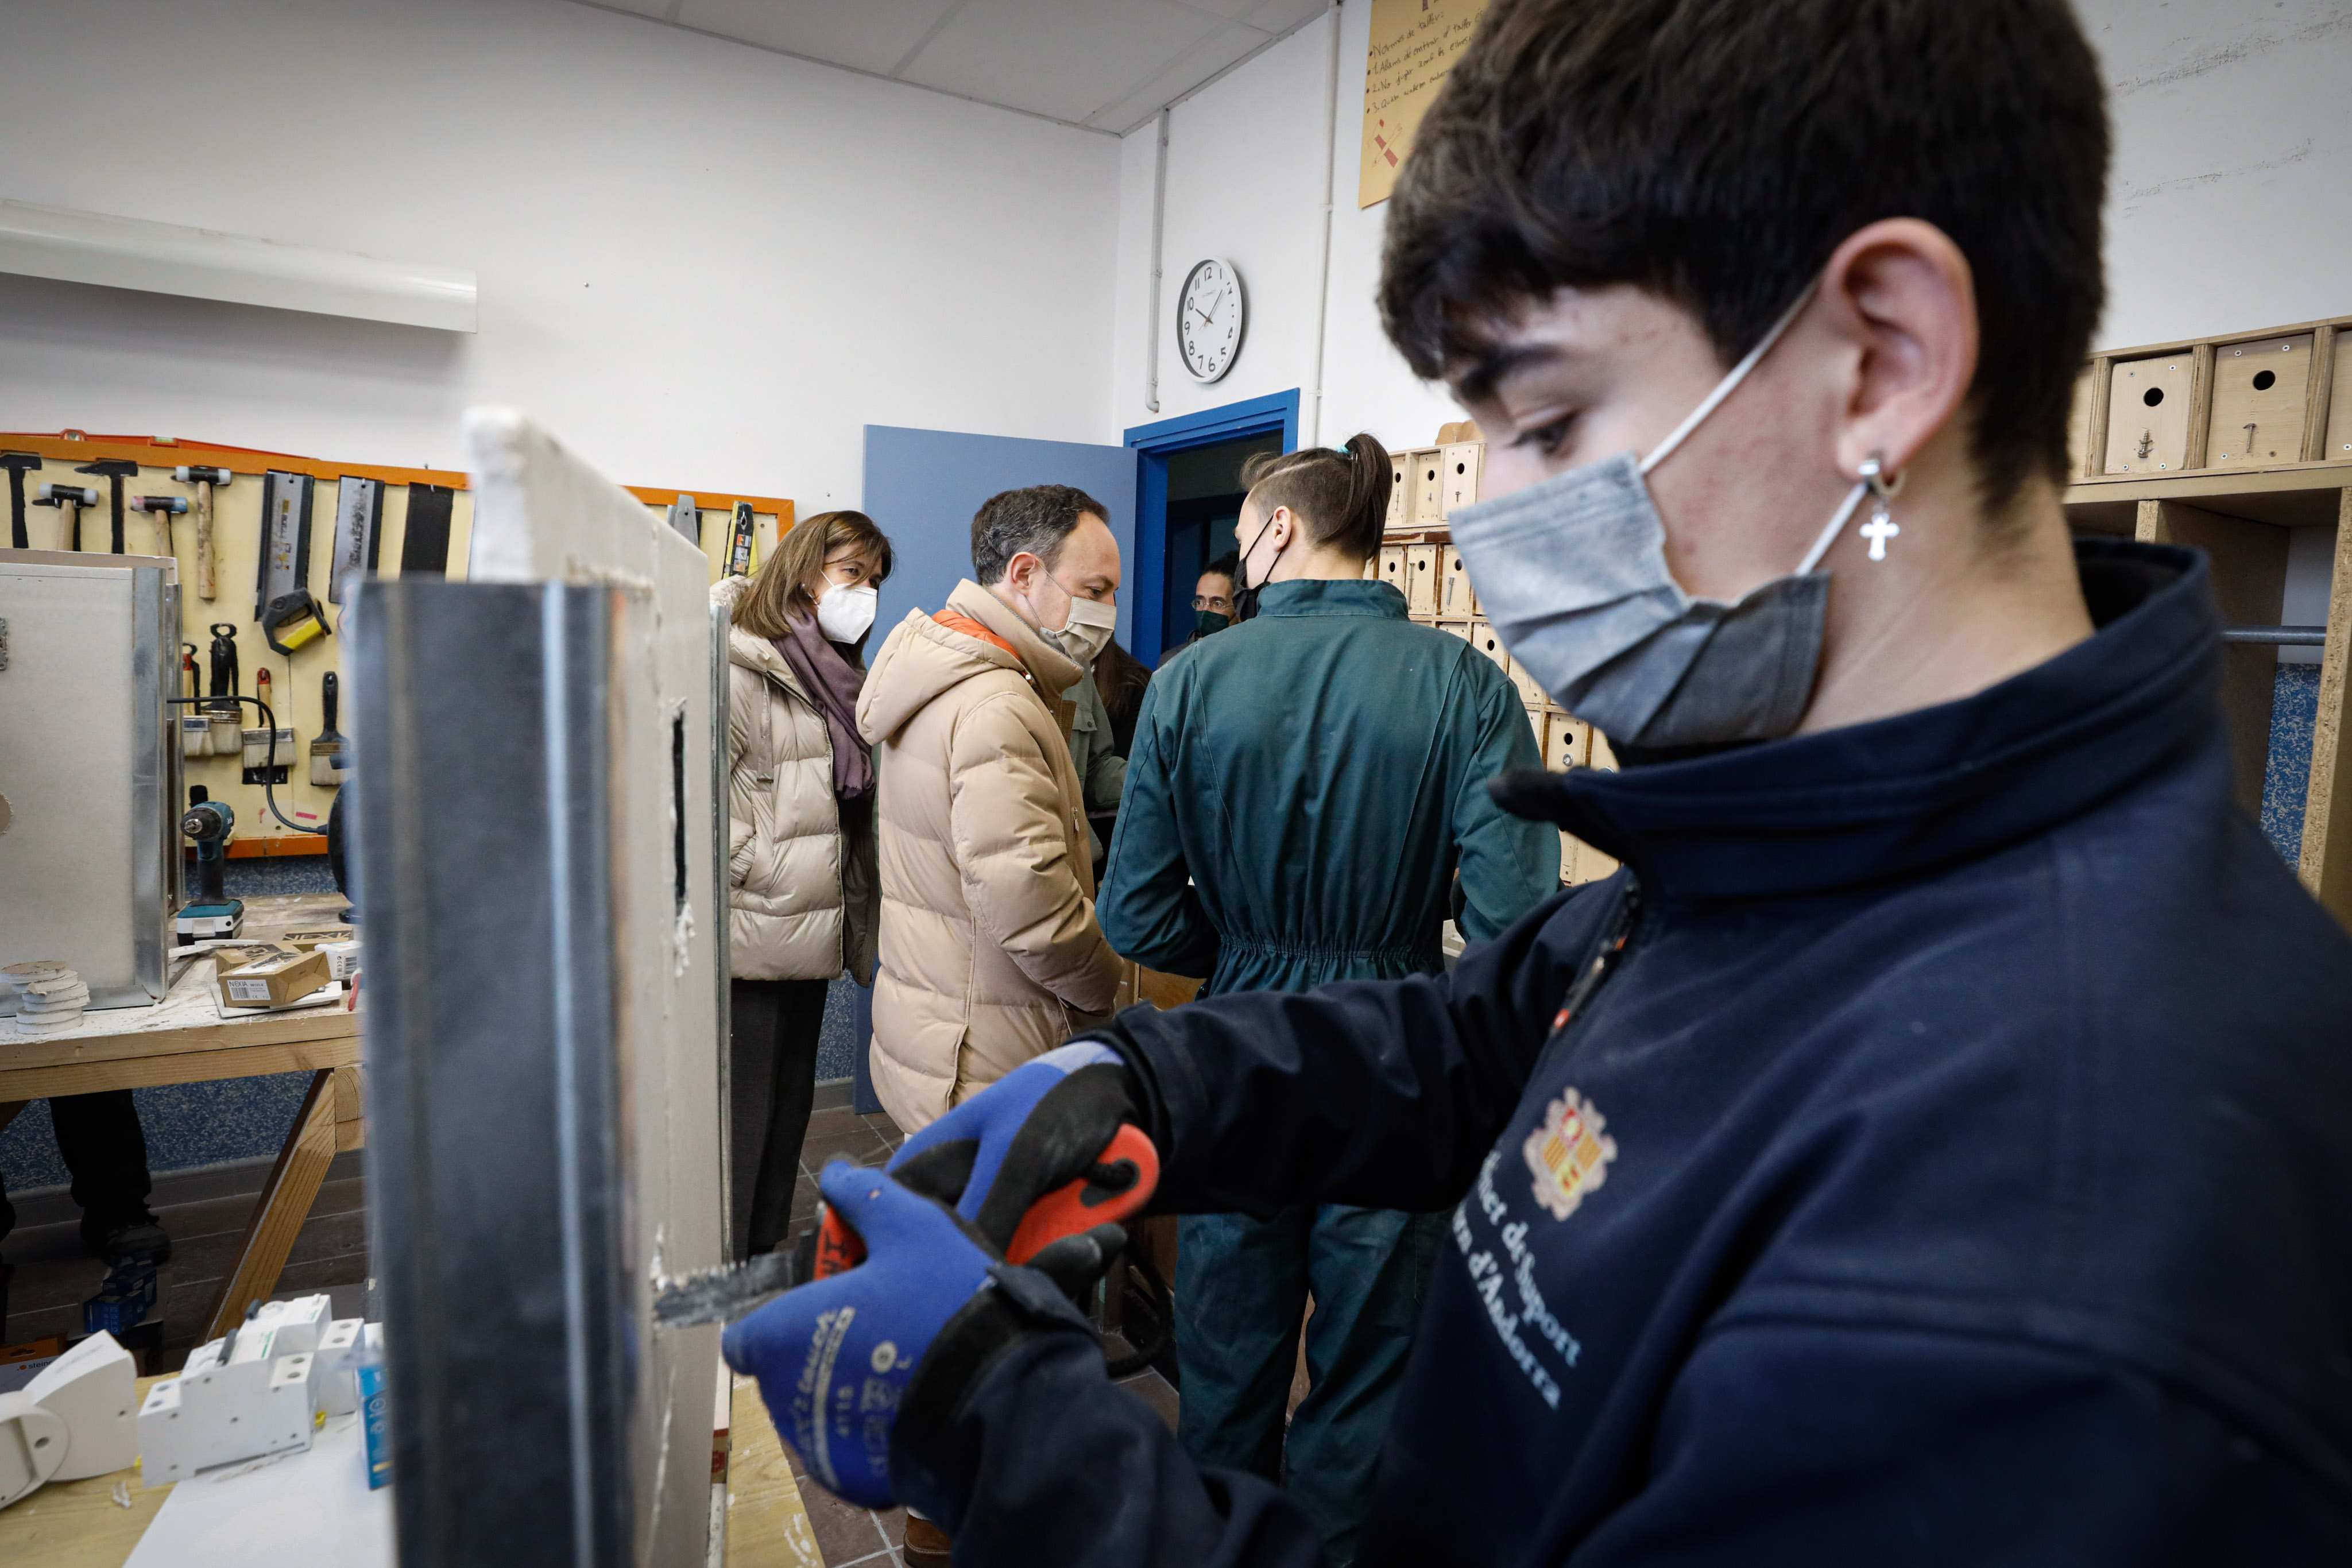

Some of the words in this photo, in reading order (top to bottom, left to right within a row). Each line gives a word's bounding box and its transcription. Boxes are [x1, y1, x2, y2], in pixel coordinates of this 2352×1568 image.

[1407, 29, 1414, 38] de
[1204, 266, 1212, 281] 12
[1195, 277, 1200, 291] 11
[1187, 297, 1194, 312] 10
[1185, 322, 1190, 335] 9
[1228, 326, 1233, 339] 4
[1189, 340, 1195, 356] 8
[1221, 347, 1227, 362] 5
[1198, 354, 1204, 369] 7
[1208, 357, 1216, 372] 6
